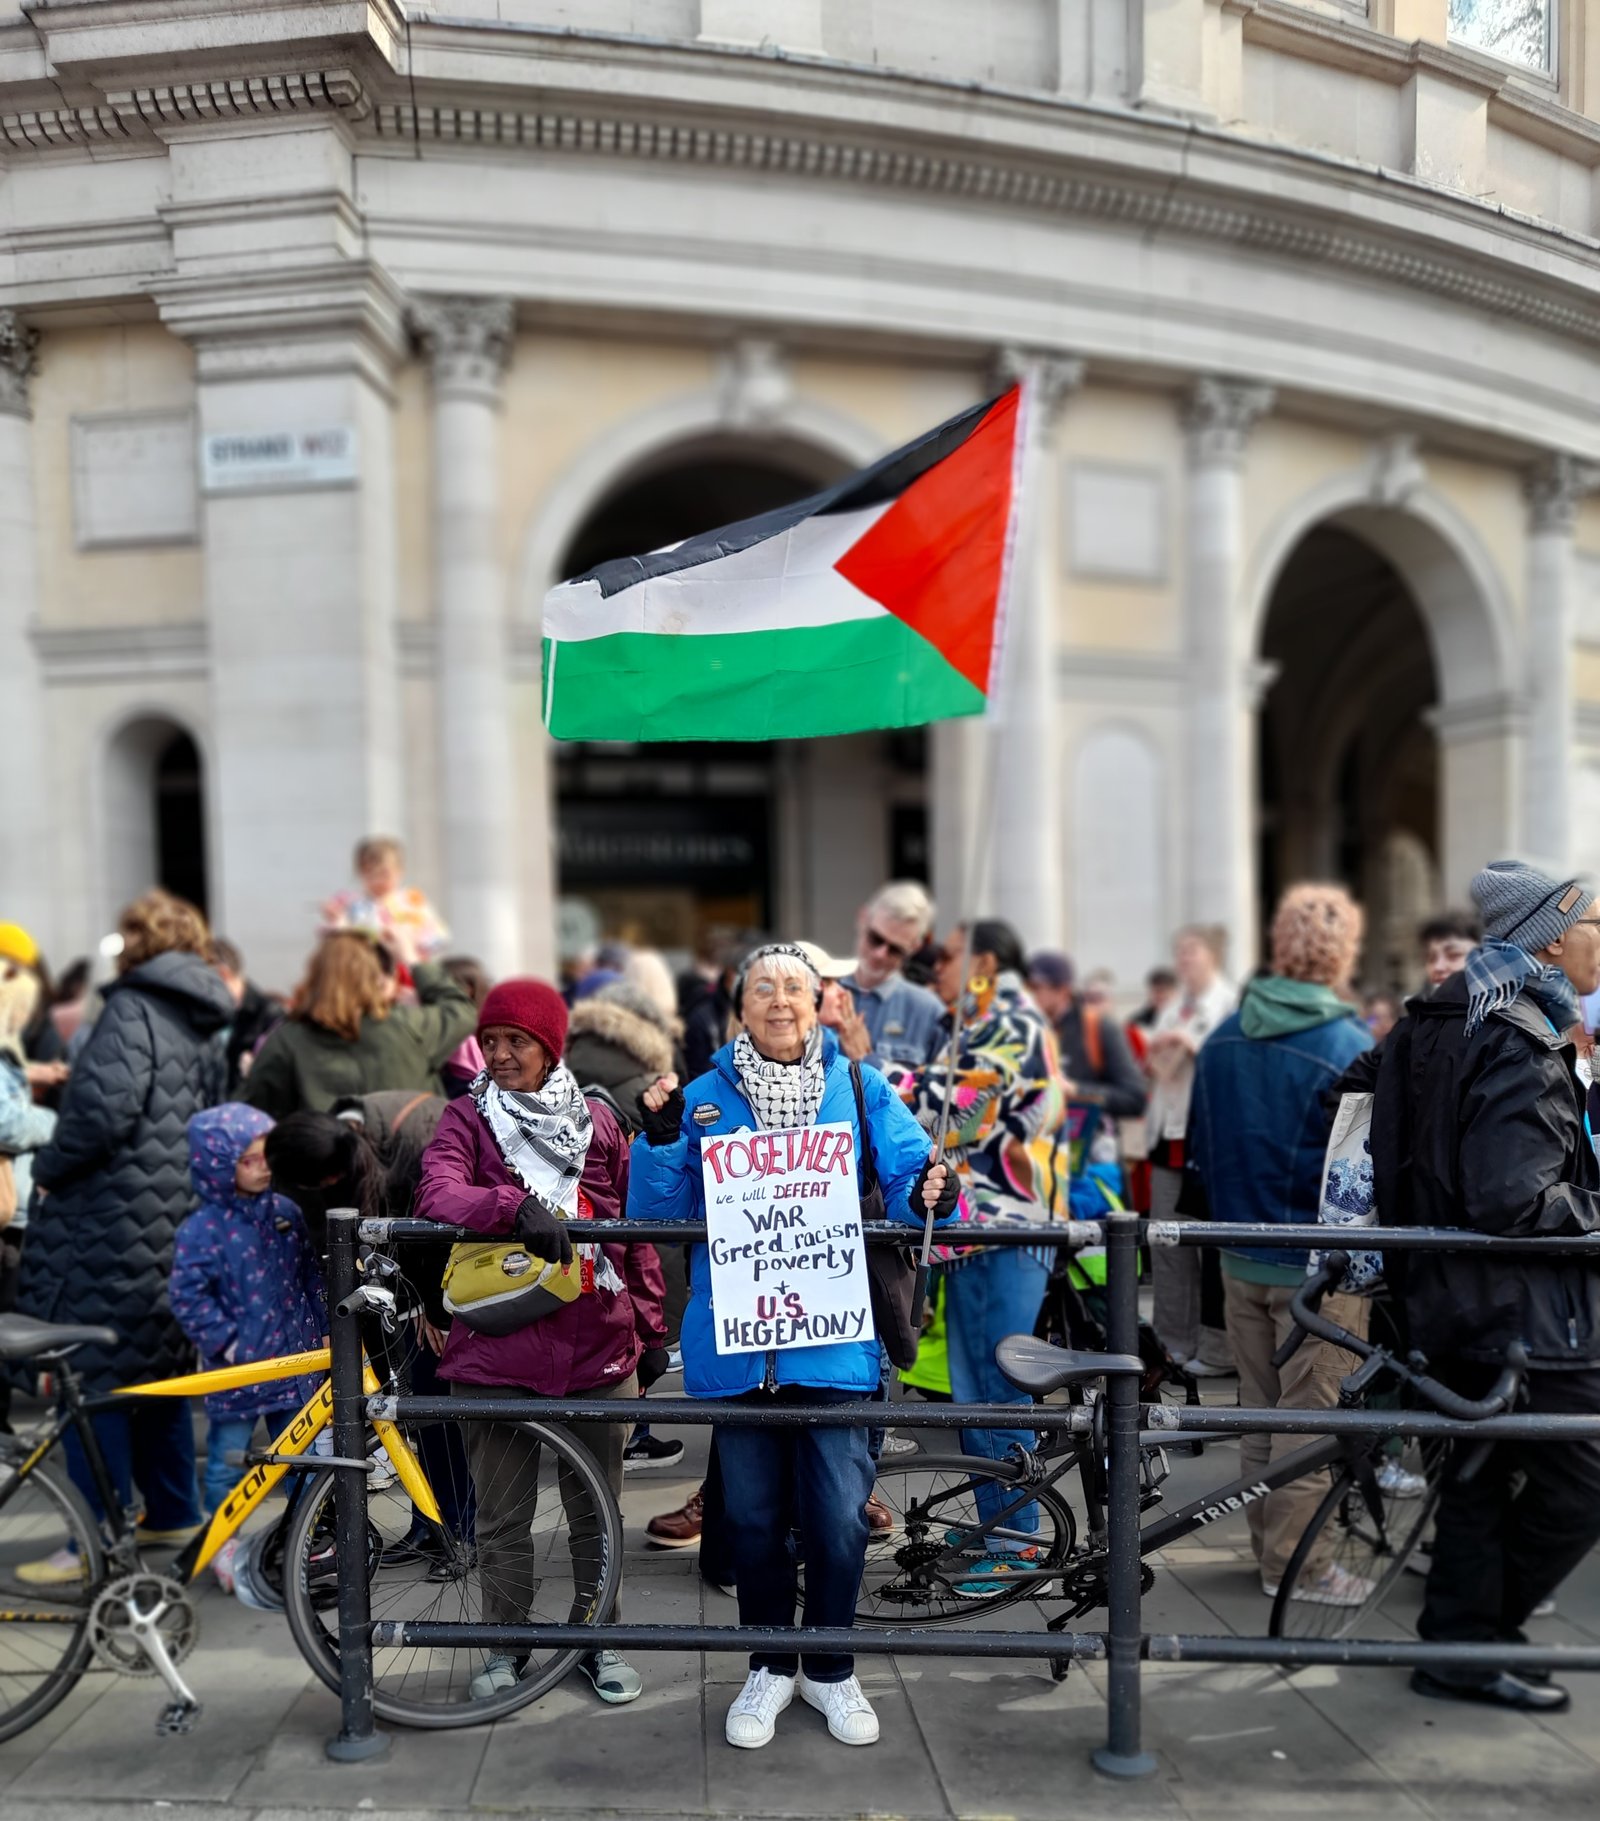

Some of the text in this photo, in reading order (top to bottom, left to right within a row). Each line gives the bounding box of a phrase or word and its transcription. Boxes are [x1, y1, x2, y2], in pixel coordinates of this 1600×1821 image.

[702, 1129, 853, 1184] TOGETHER
[716, 1181, 831, 1205] we will DEFEAT
[742, 1204, 807, 1234] WAR
[794, 1222, 860, 1250] racism
[753, 1244, 855, 1282] poverty
[723, 1307, 867, 1347] HEGEMONY
[1192, 1481, 1271, 1524] TRIBAN
